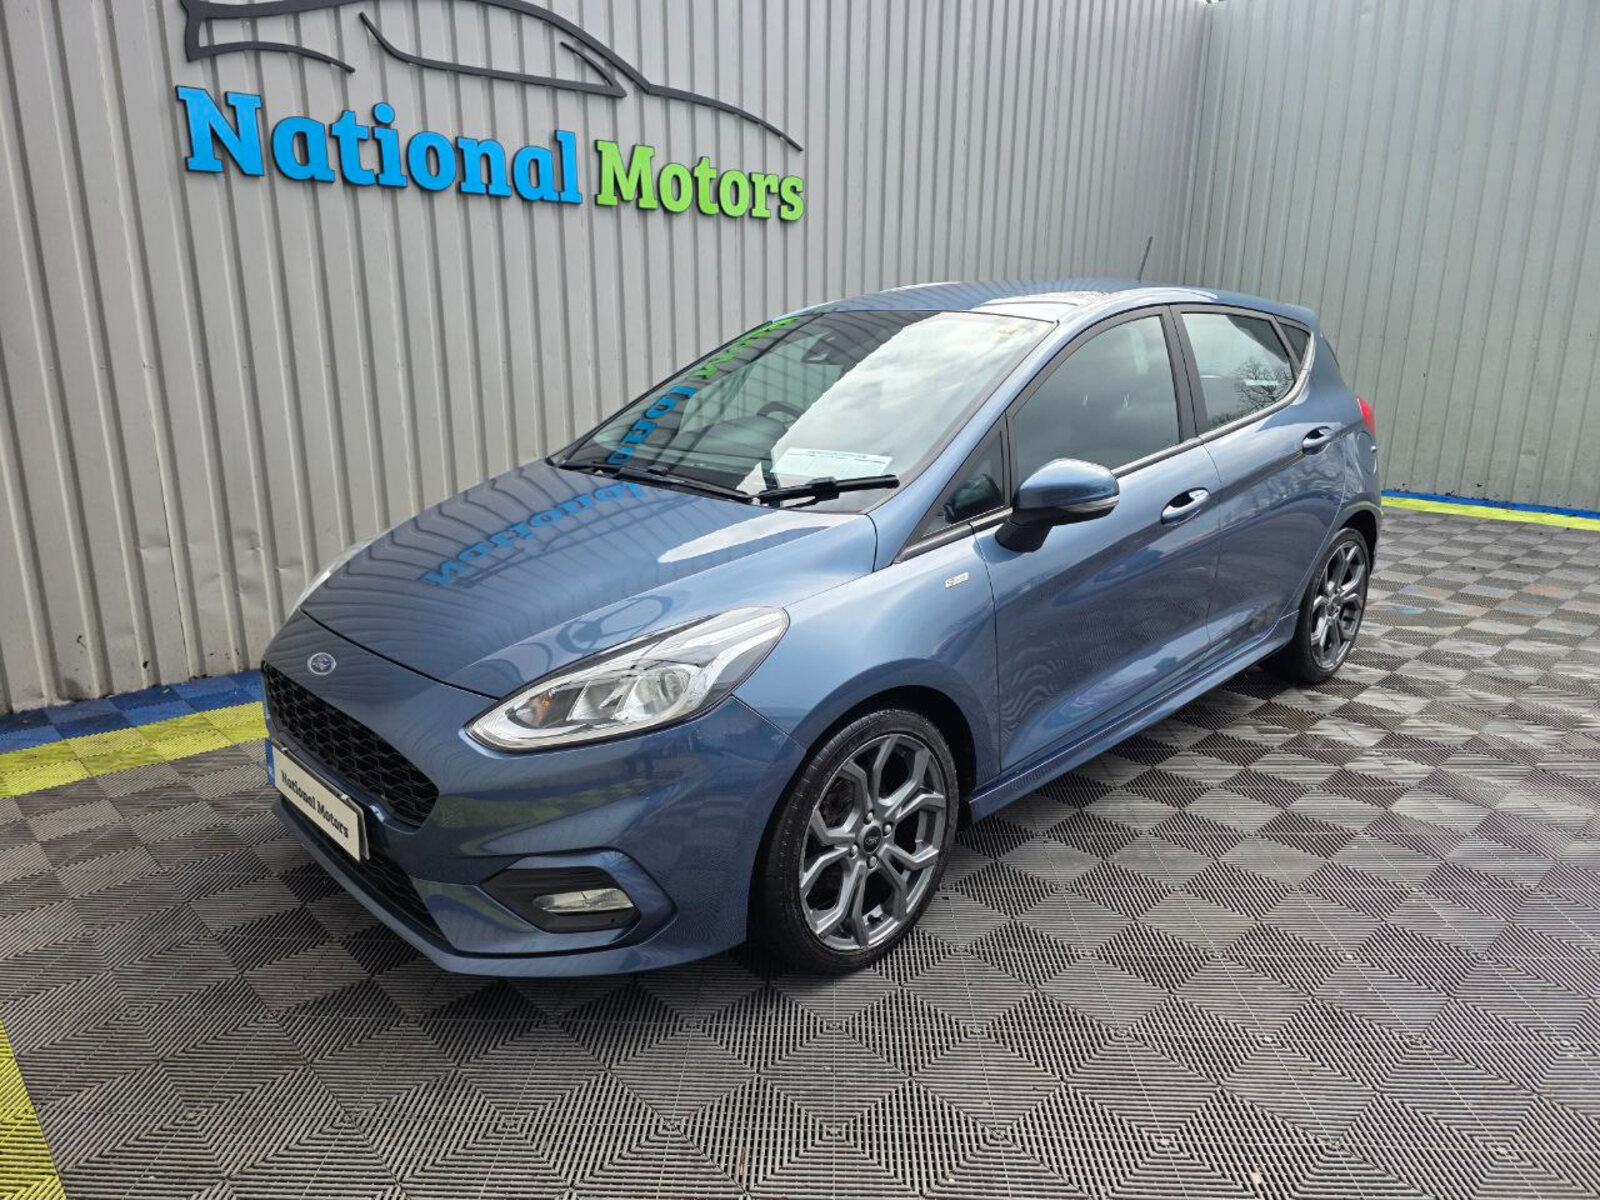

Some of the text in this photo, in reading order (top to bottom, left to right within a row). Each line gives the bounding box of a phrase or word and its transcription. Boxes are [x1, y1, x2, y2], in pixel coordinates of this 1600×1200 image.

[175, 85, 805, 222] National Motors
[280, 769, 349, 839] National Motors
